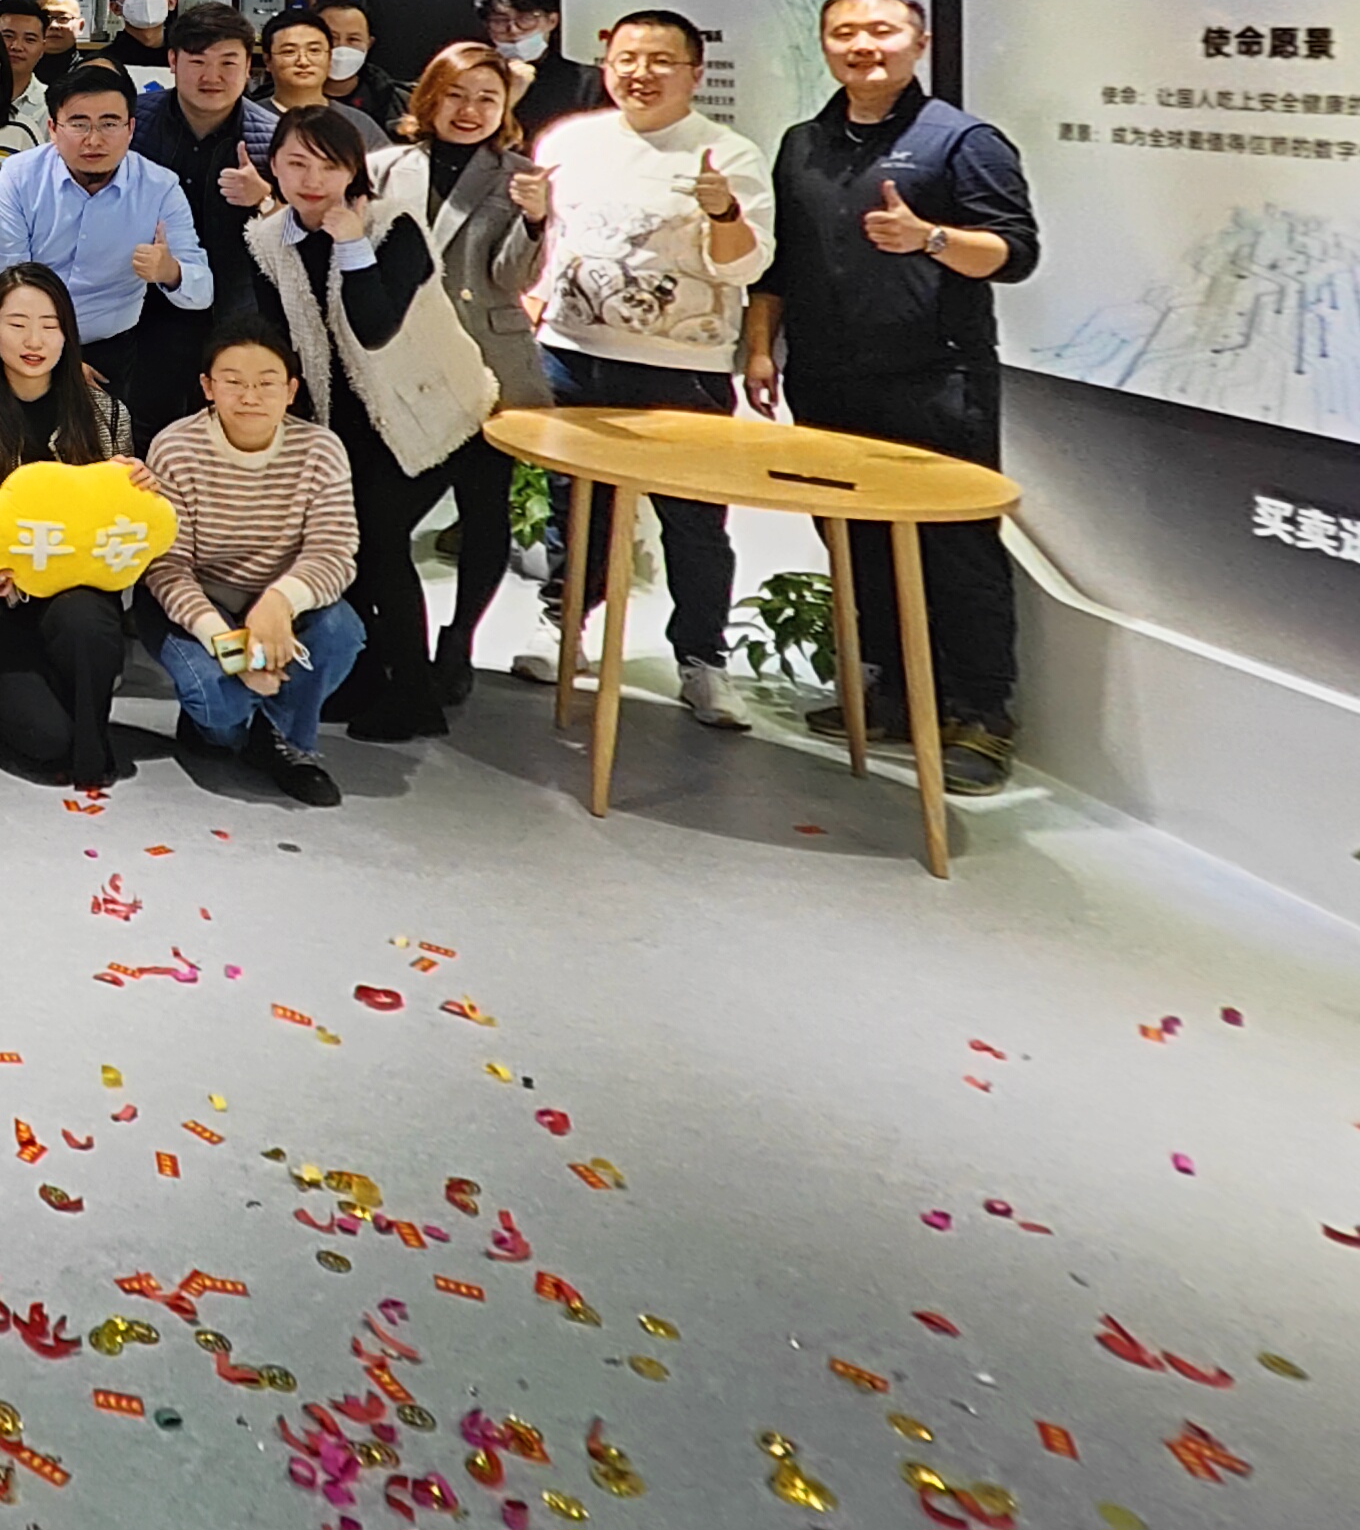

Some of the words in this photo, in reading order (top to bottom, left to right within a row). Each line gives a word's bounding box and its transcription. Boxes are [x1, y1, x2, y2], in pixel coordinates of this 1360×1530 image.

[1202, 27, 1336, 59] 使命愿景
[9, 514, 148, 572] 平安
